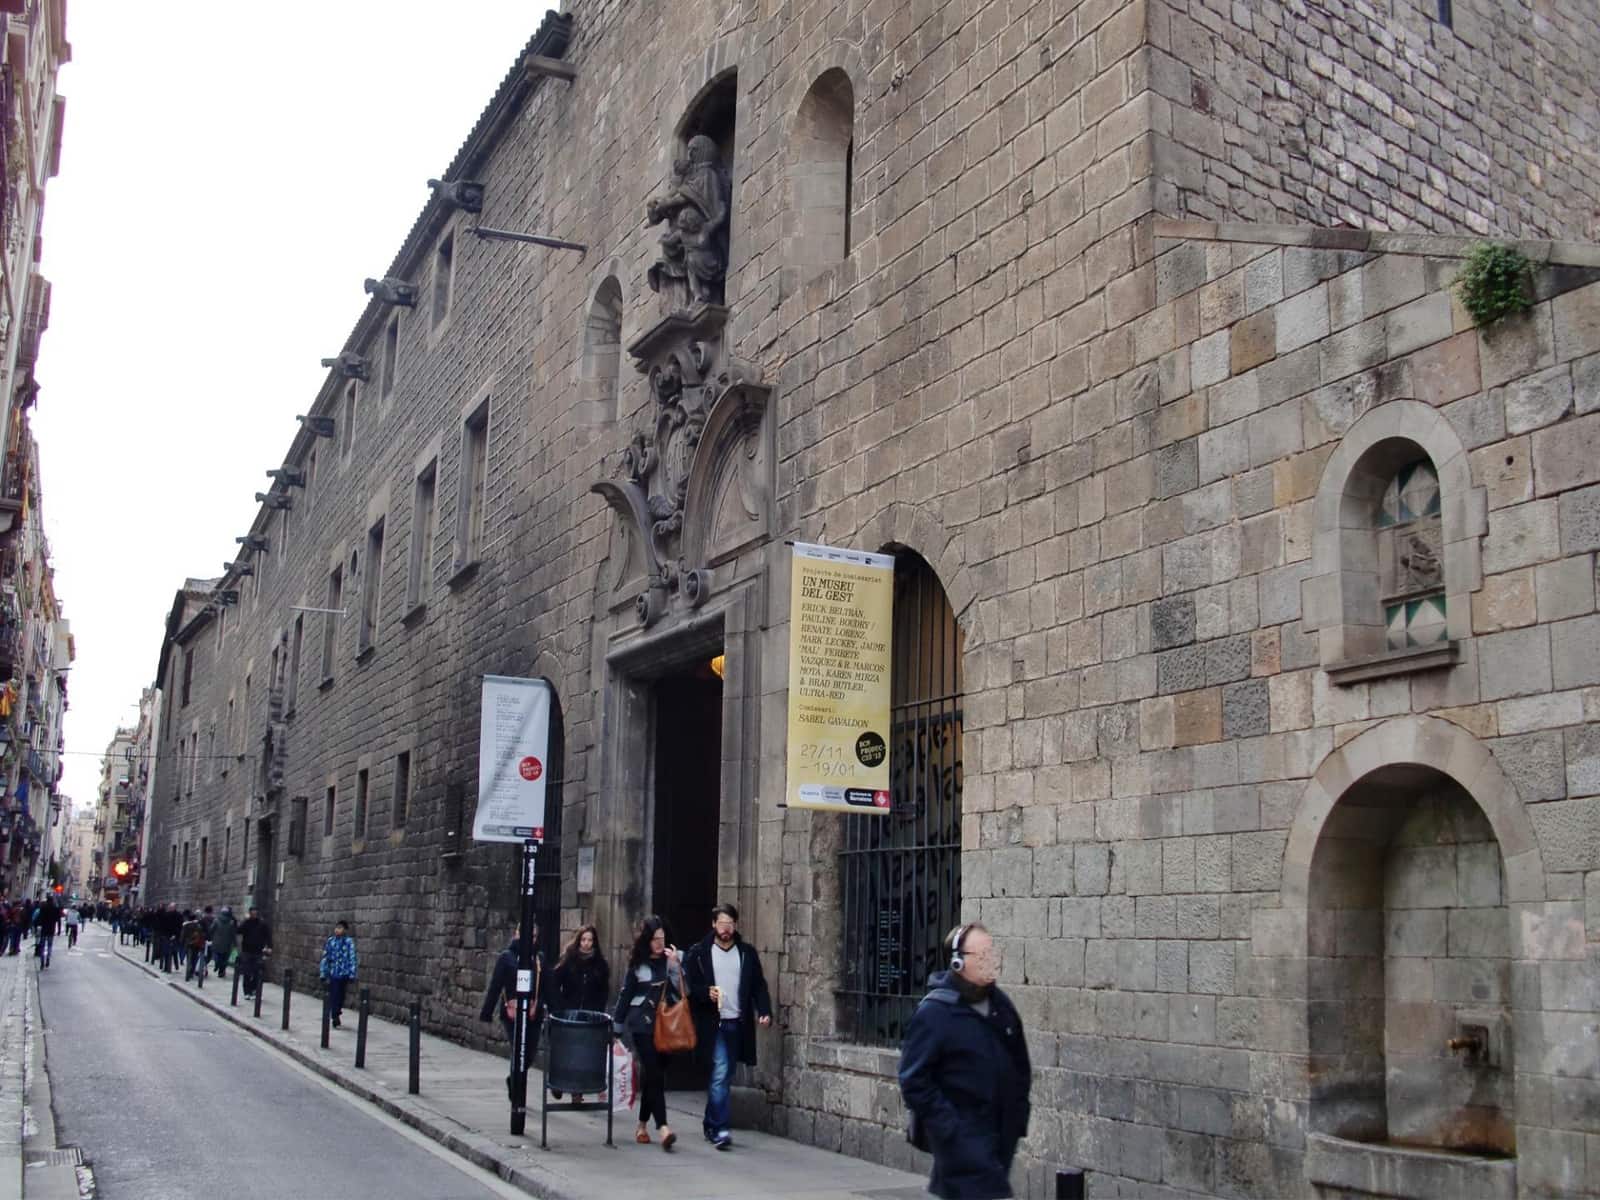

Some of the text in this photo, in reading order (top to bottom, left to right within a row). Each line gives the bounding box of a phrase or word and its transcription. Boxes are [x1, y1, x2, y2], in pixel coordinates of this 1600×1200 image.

[802, 576, 855, 592] UN MUSEU
[801, 587, 854, 602] DEL GEST
[801, 603, 827, 614] ERICK
[801, 614, 837, 625] PAULINE
[801, 624, 832, 635] RENATE
[800, 635, 886, 653] MARK LECKEY, JAUME
[837, 659, 843, 668] &
[854, 662, 887, 674] MARCOS
[800, 677, 805, 685] &
[808, 677, 831, 689] BRAD
[826, 669, 853, 680] KAREN
[855, 672, 880, 683] MIRZA
[800, 688, 845, 700] ULTRA-RED
[799, 713, 825, 724] SABEL
[800, 743, 842, 759] 27/11
[814, 761, 856, 777] 19/01
